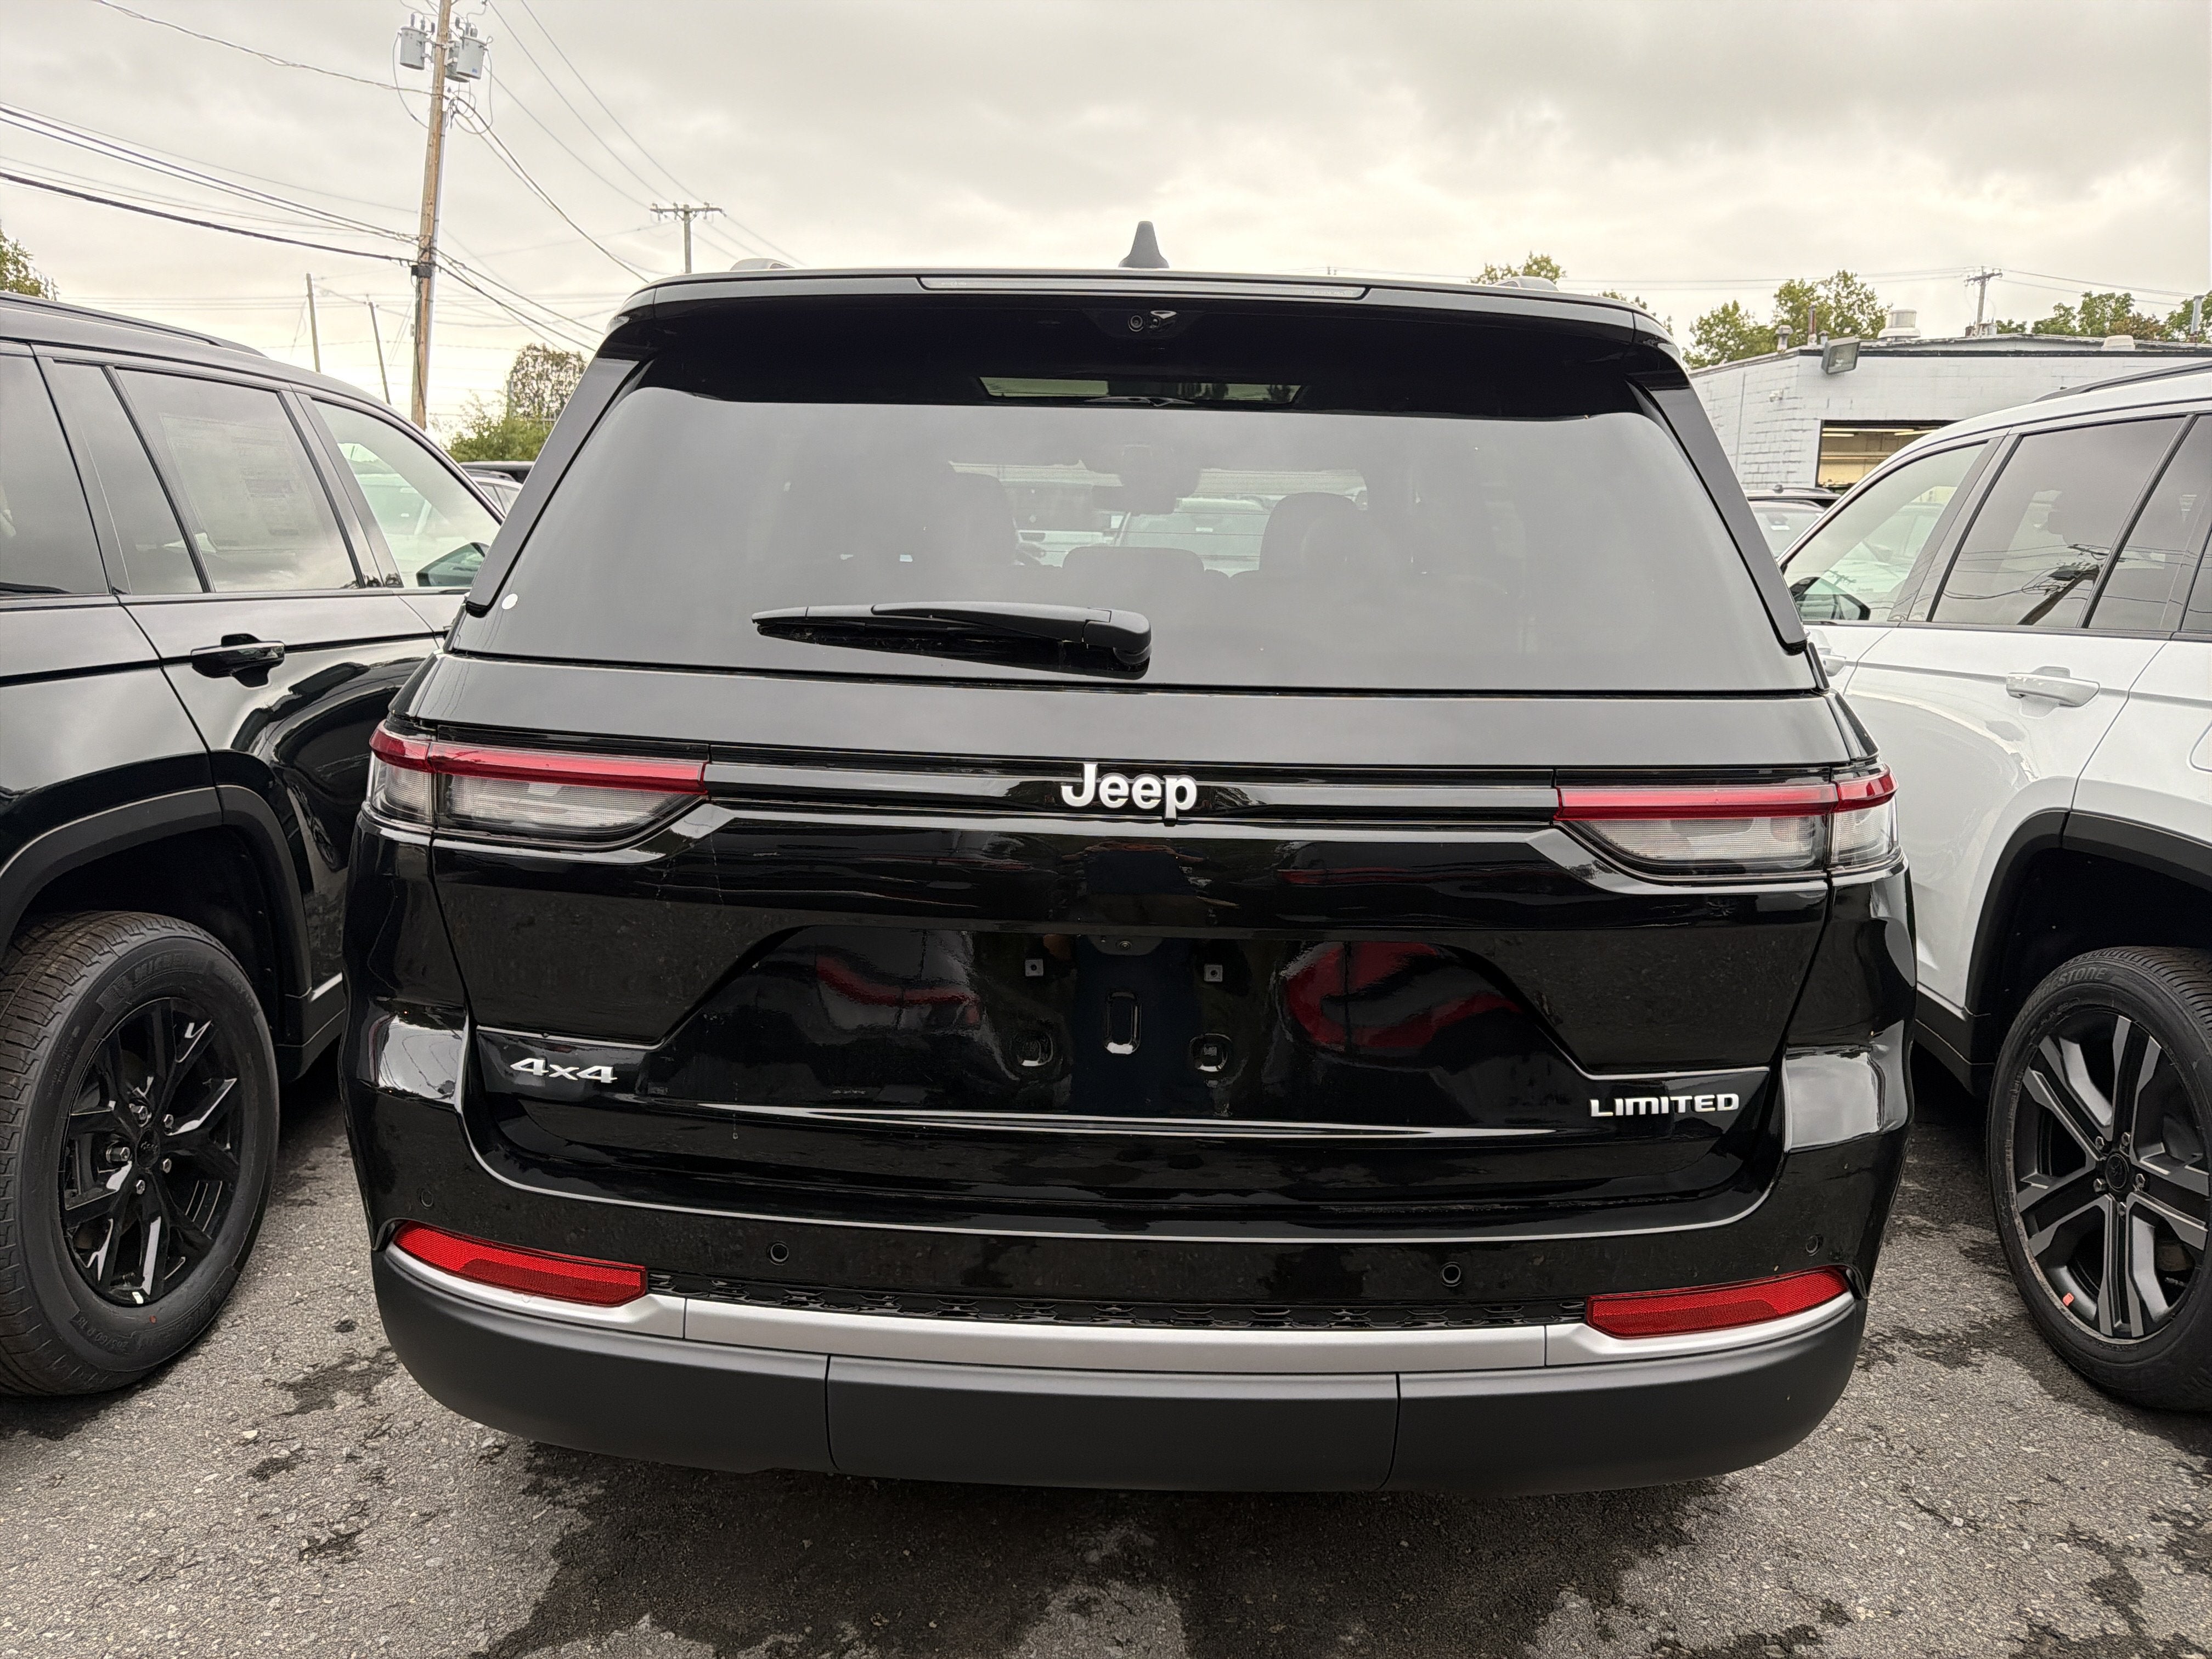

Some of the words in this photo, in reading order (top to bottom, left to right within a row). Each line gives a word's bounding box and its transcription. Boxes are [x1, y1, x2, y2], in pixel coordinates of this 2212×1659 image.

[1060, 763, 1198, 820] Jeep
[510, 1057, 618, 1084] 4x4
[1590, 1093, 1740, 1118] LIMITED
